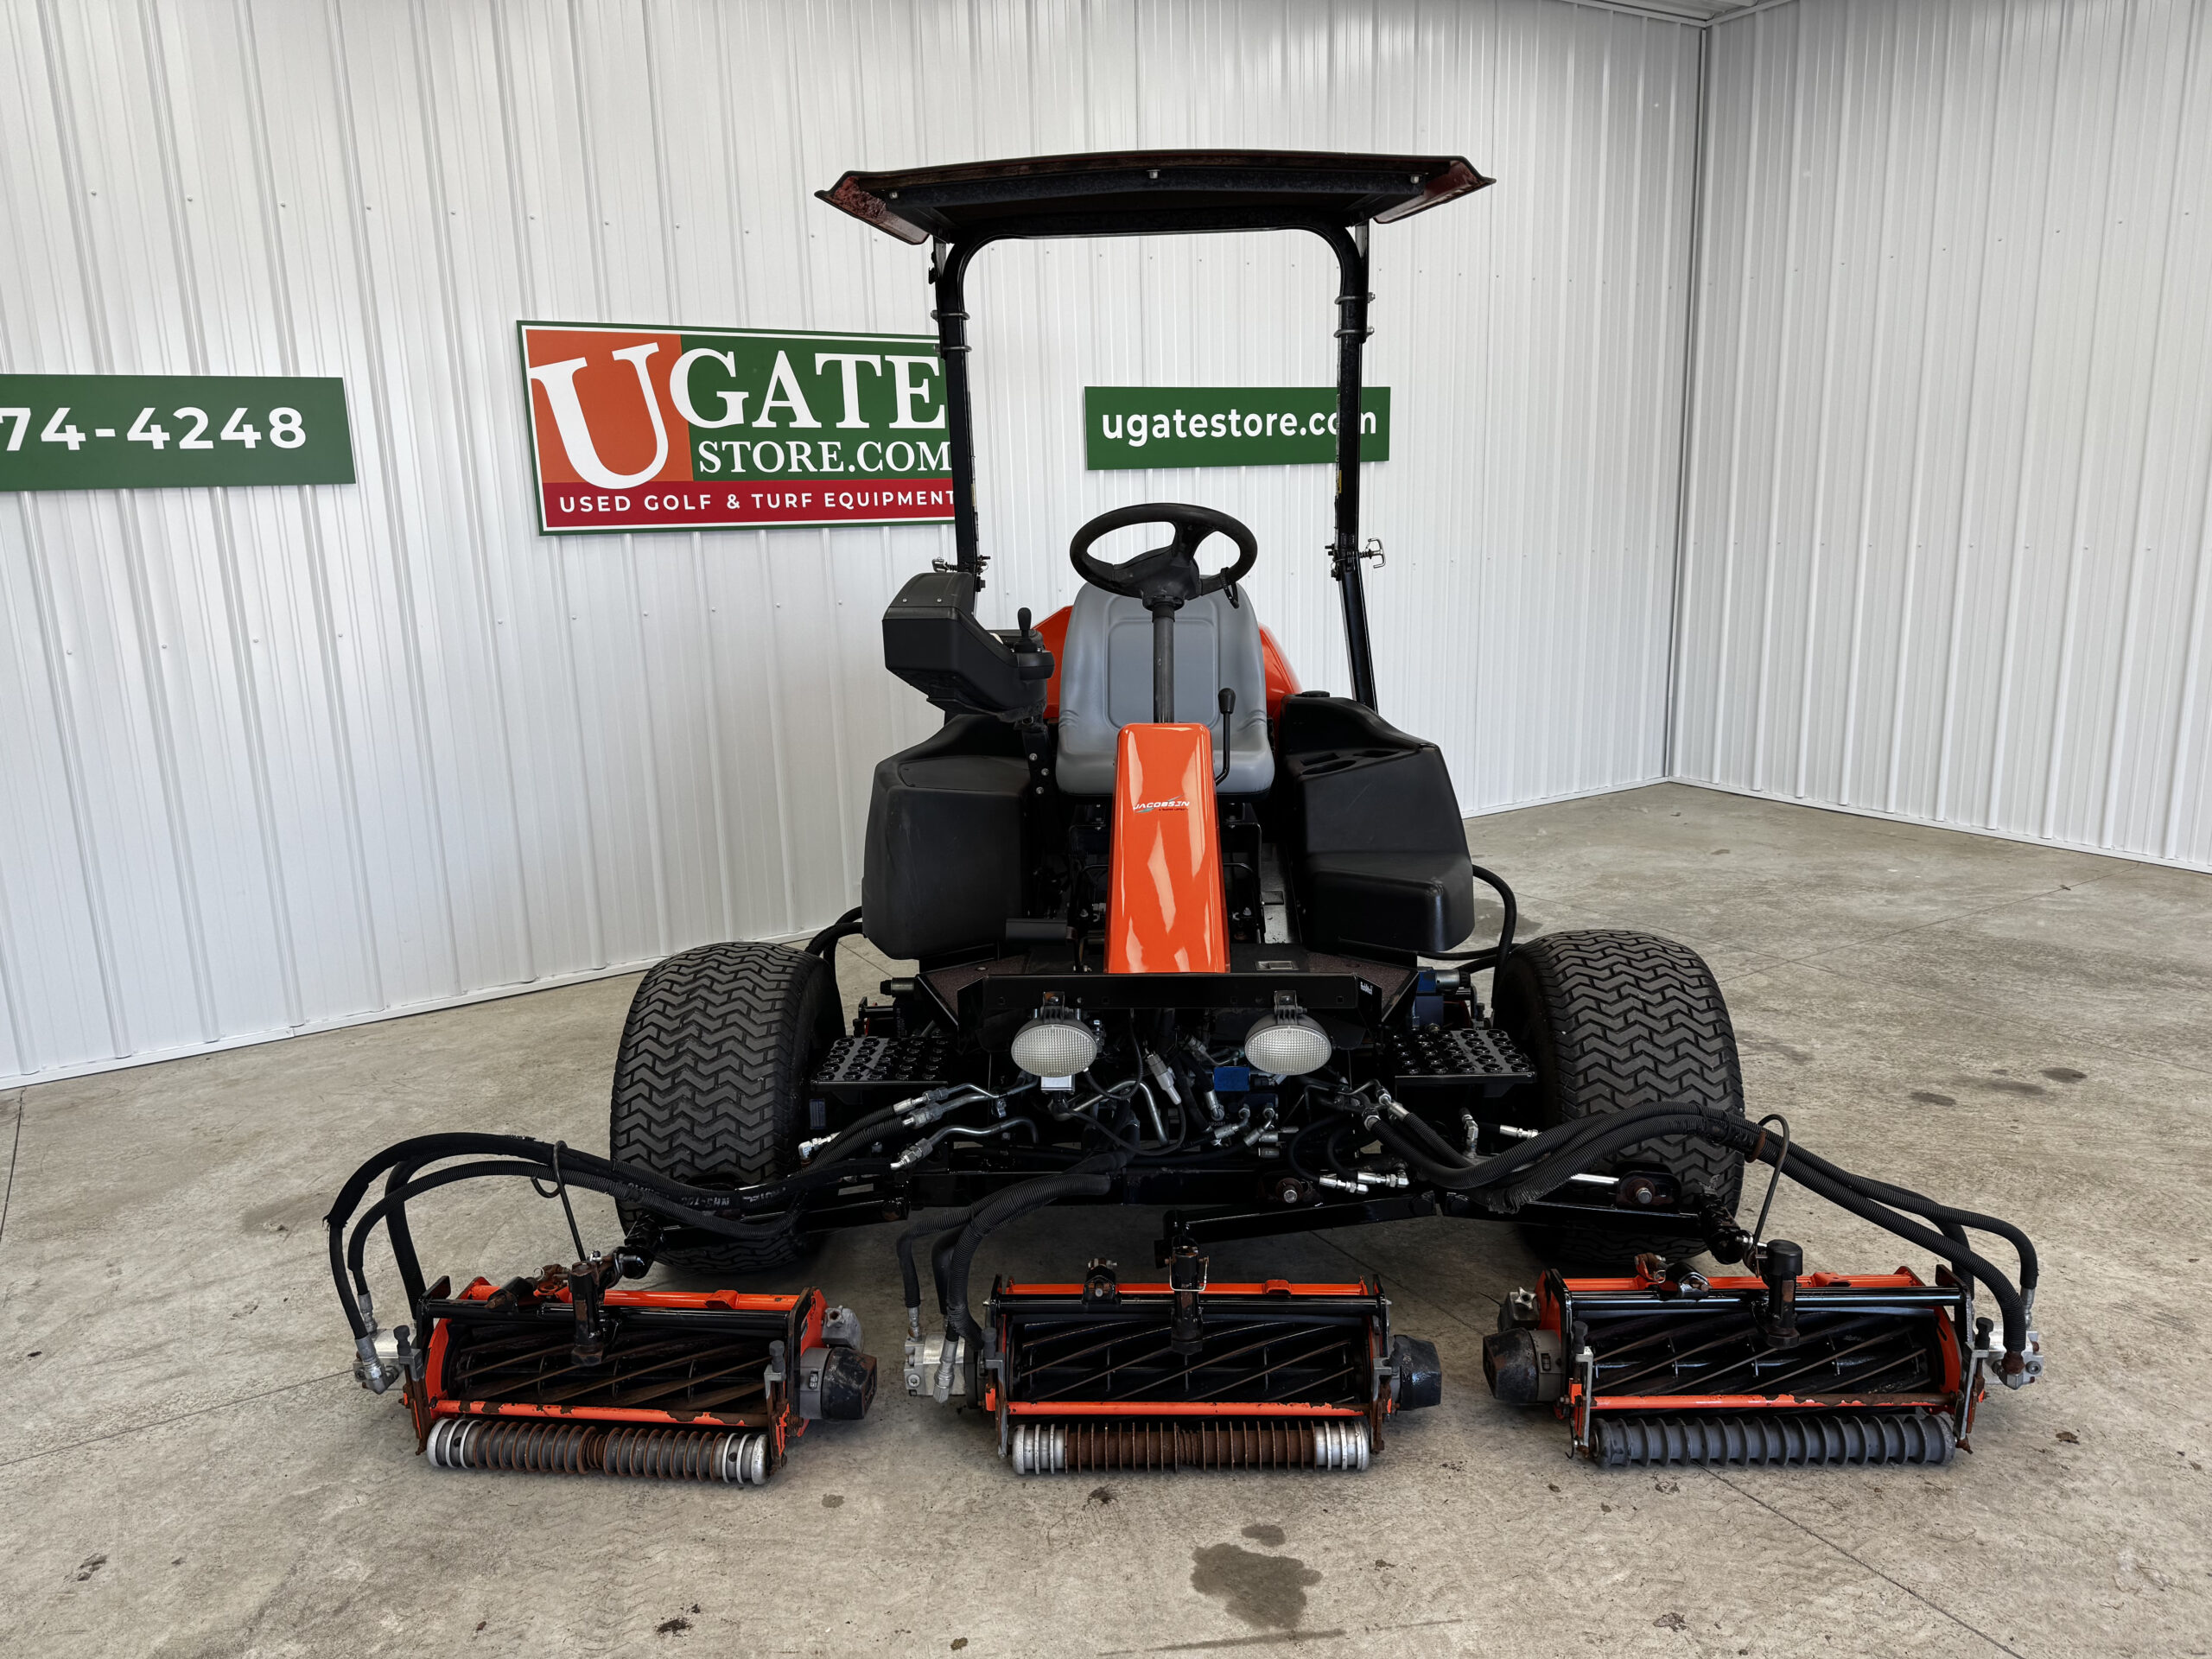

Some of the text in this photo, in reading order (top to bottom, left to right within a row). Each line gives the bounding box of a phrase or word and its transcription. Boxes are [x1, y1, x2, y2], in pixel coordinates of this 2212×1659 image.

[699, 441, 952, 474] STORE.COM
[559, 490, 954, 513] USED GOLF & TURF EQUIPMENT
[1132, 800, 1191, 810] JACOBSEN
